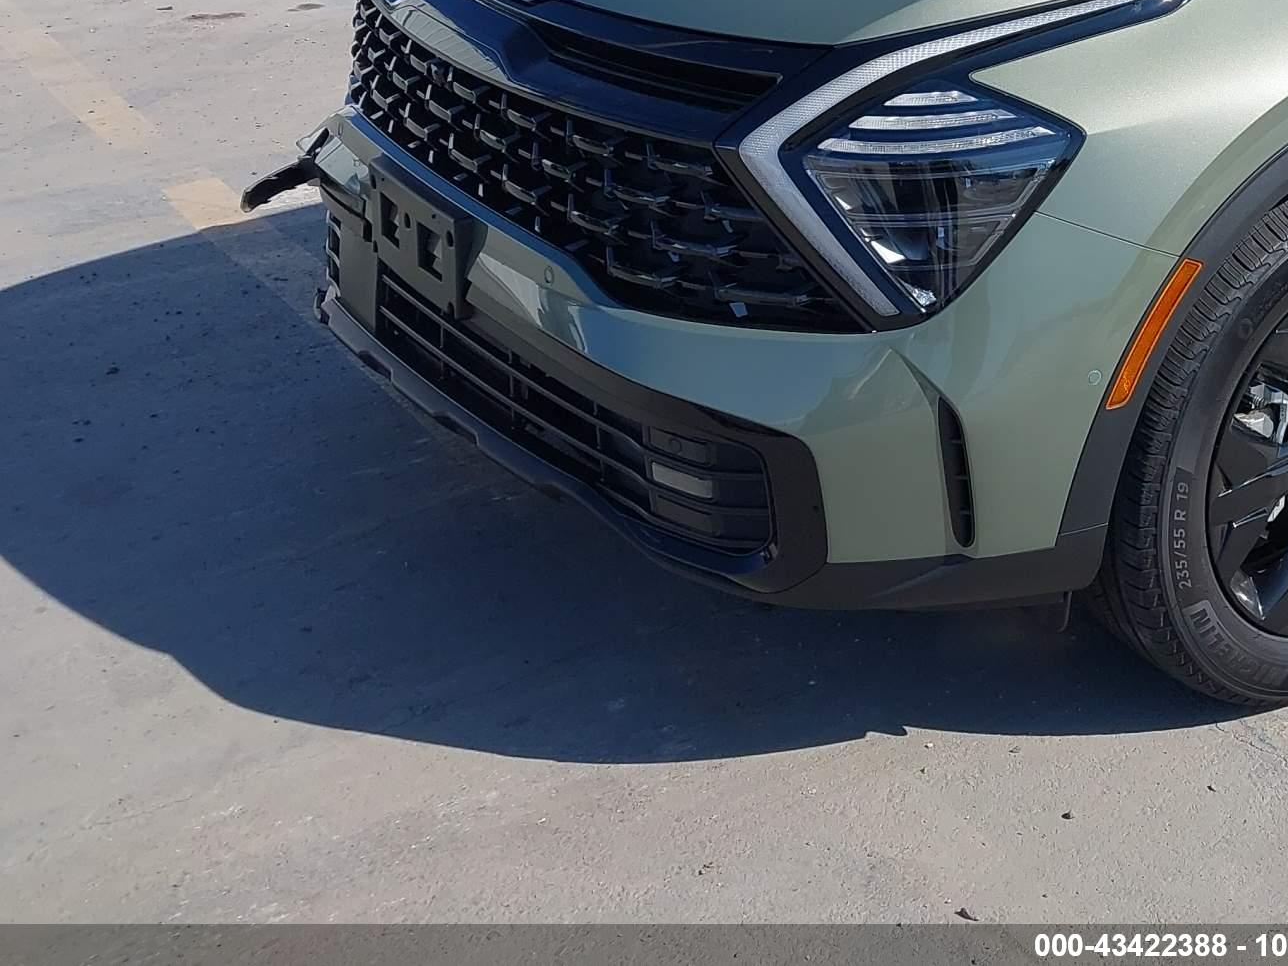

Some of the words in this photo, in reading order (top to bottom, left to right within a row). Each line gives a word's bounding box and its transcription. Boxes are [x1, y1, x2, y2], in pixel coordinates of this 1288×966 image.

[1176, 482, 1189, 501] 19
[1174, 509, 1187, 521] R
[1173, 528, 1193, 590] 235/55
